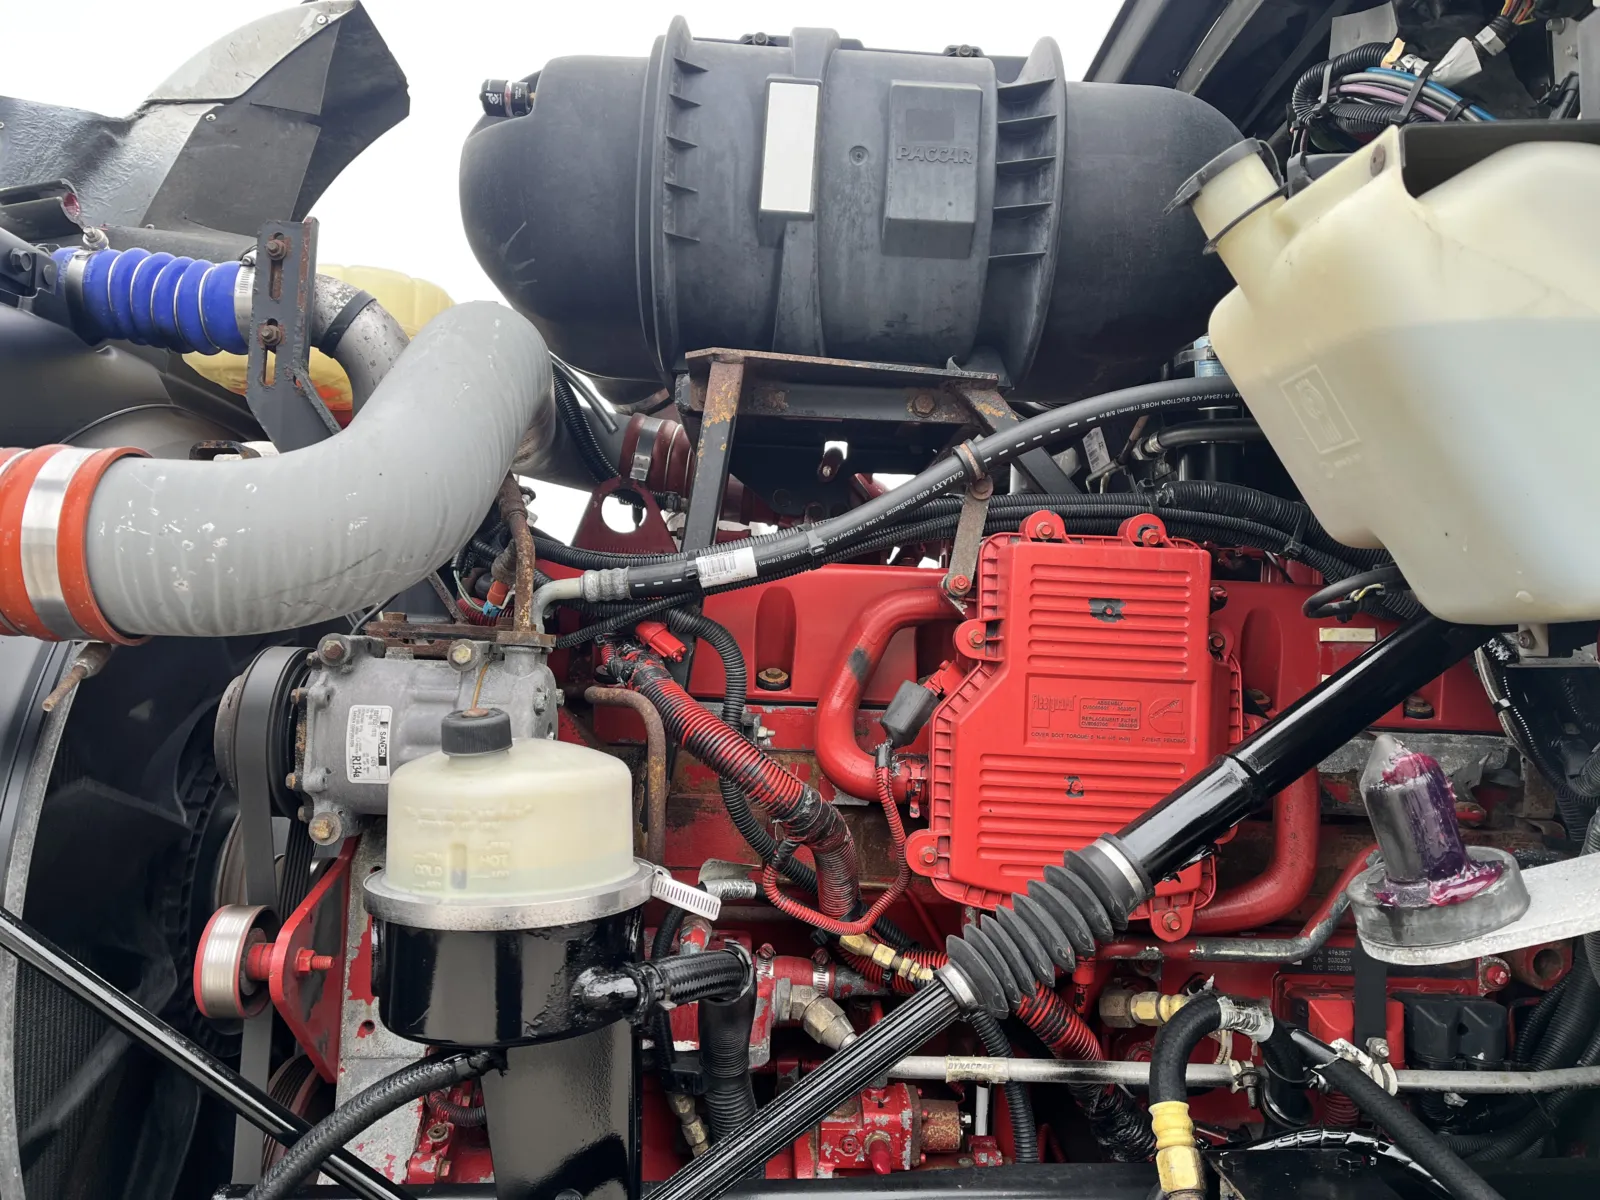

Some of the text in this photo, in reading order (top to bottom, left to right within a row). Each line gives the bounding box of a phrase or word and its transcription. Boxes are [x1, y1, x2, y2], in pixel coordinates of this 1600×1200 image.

[896, 145, 973, 164] PACCAR
[1161, 396, 1190, 406] SUCTION
[1116, 404, 1141, 415] (16mm)
[932, 470, 964, 492] GALAXY
[886, 496, 916, 517] FlexBarrier
[865, 514, 885, 527] R-134a
[839, 524, 863, 540] R-1234yf
[828, 536, 838, 545] A/C
[758, 550, 800, 566] HOSE (16mm)
[352, 756, 362, 778] R134a
